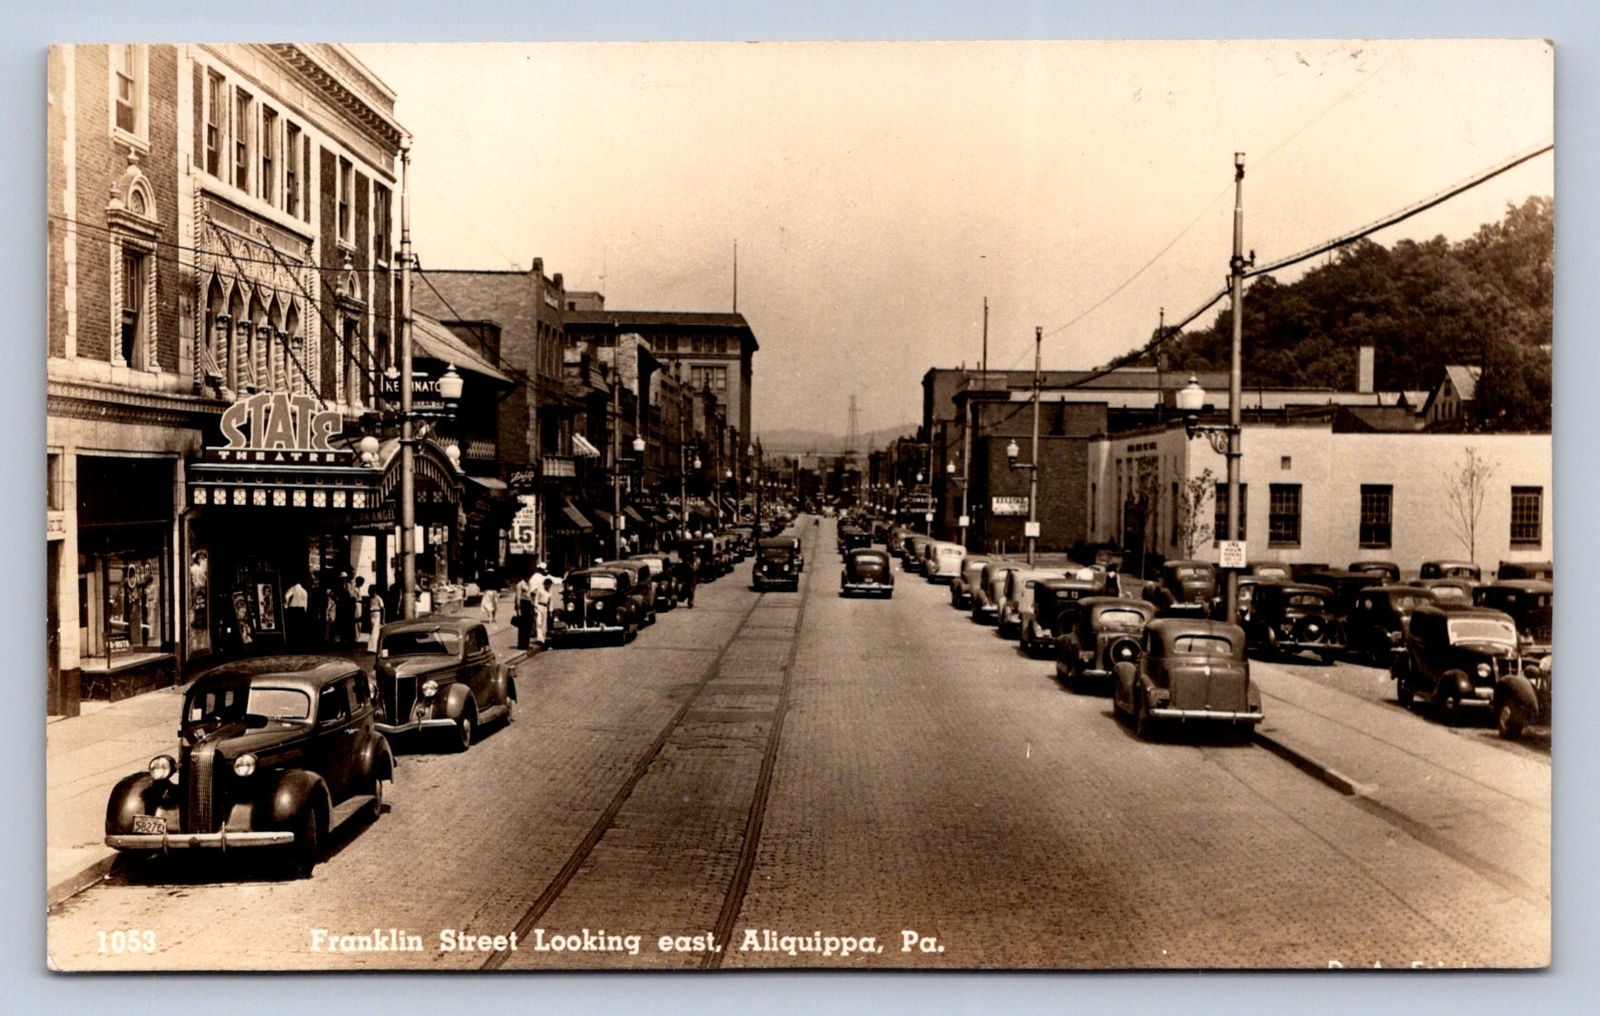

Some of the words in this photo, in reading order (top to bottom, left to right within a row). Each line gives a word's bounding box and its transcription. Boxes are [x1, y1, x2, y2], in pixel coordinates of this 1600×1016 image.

[386, 381, 441, 392] KEINATO
[220, 391, 343, 450] STATE
[218, 450, 335, 462] THEATRE
